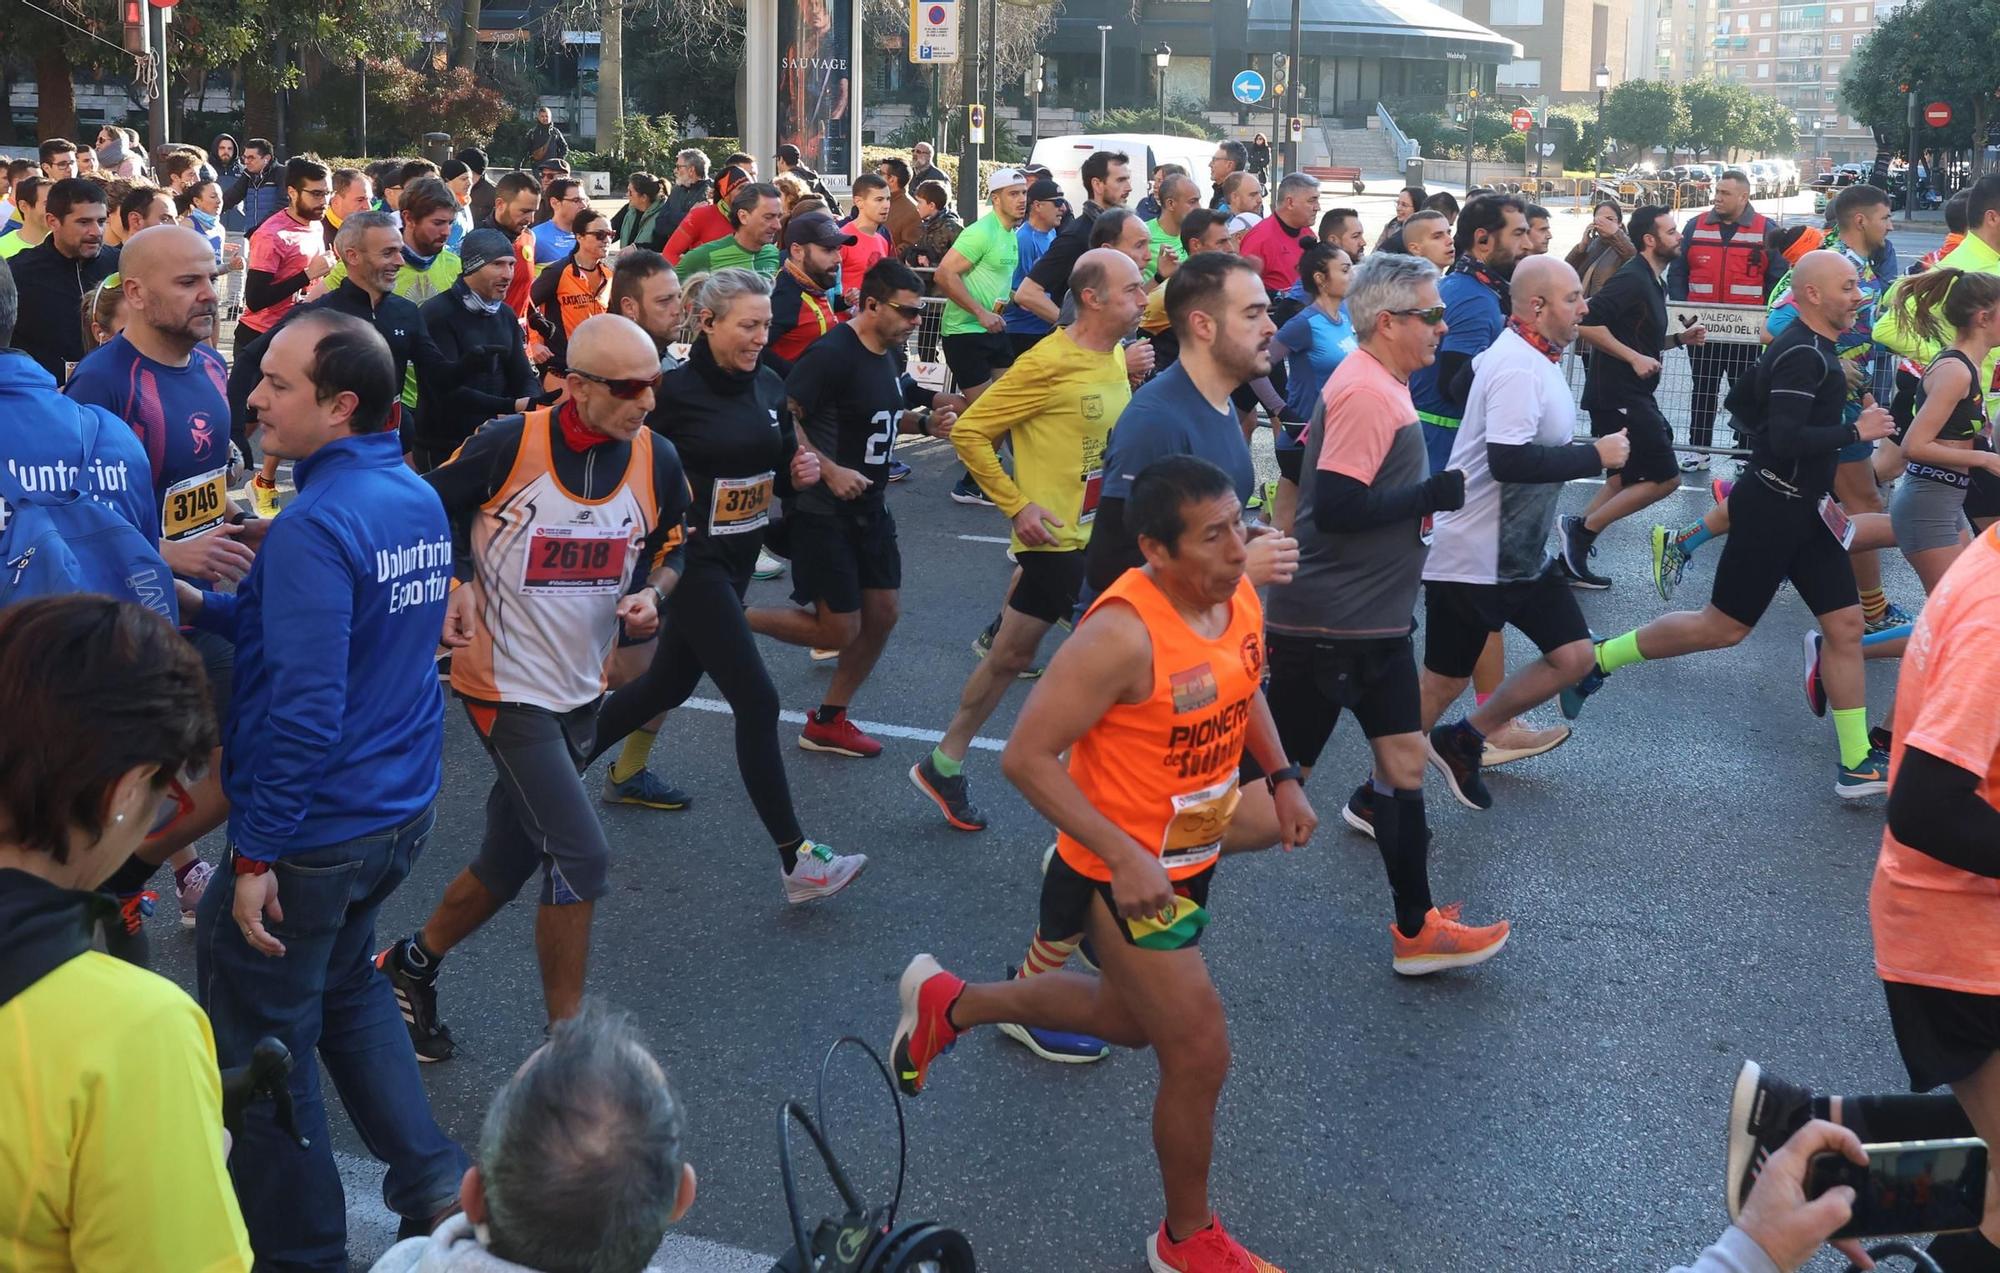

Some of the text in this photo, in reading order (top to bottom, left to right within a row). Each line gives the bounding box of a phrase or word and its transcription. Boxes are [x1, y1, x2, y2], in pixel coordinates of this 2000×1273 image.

[782, 58, 847, 70] SAUVAGE
[1700, 312, 1743, 323] VALENCIA
[1701, 323, 1732, 334] IUDAD
[1734, 325, 1752, 335] DEL
[1920, 466, 1957, 483] PRO
[173, 482, 219, 522] 3746
[726, 484, 764, 512] 3734
[542, 541, 610, 569] 2618
